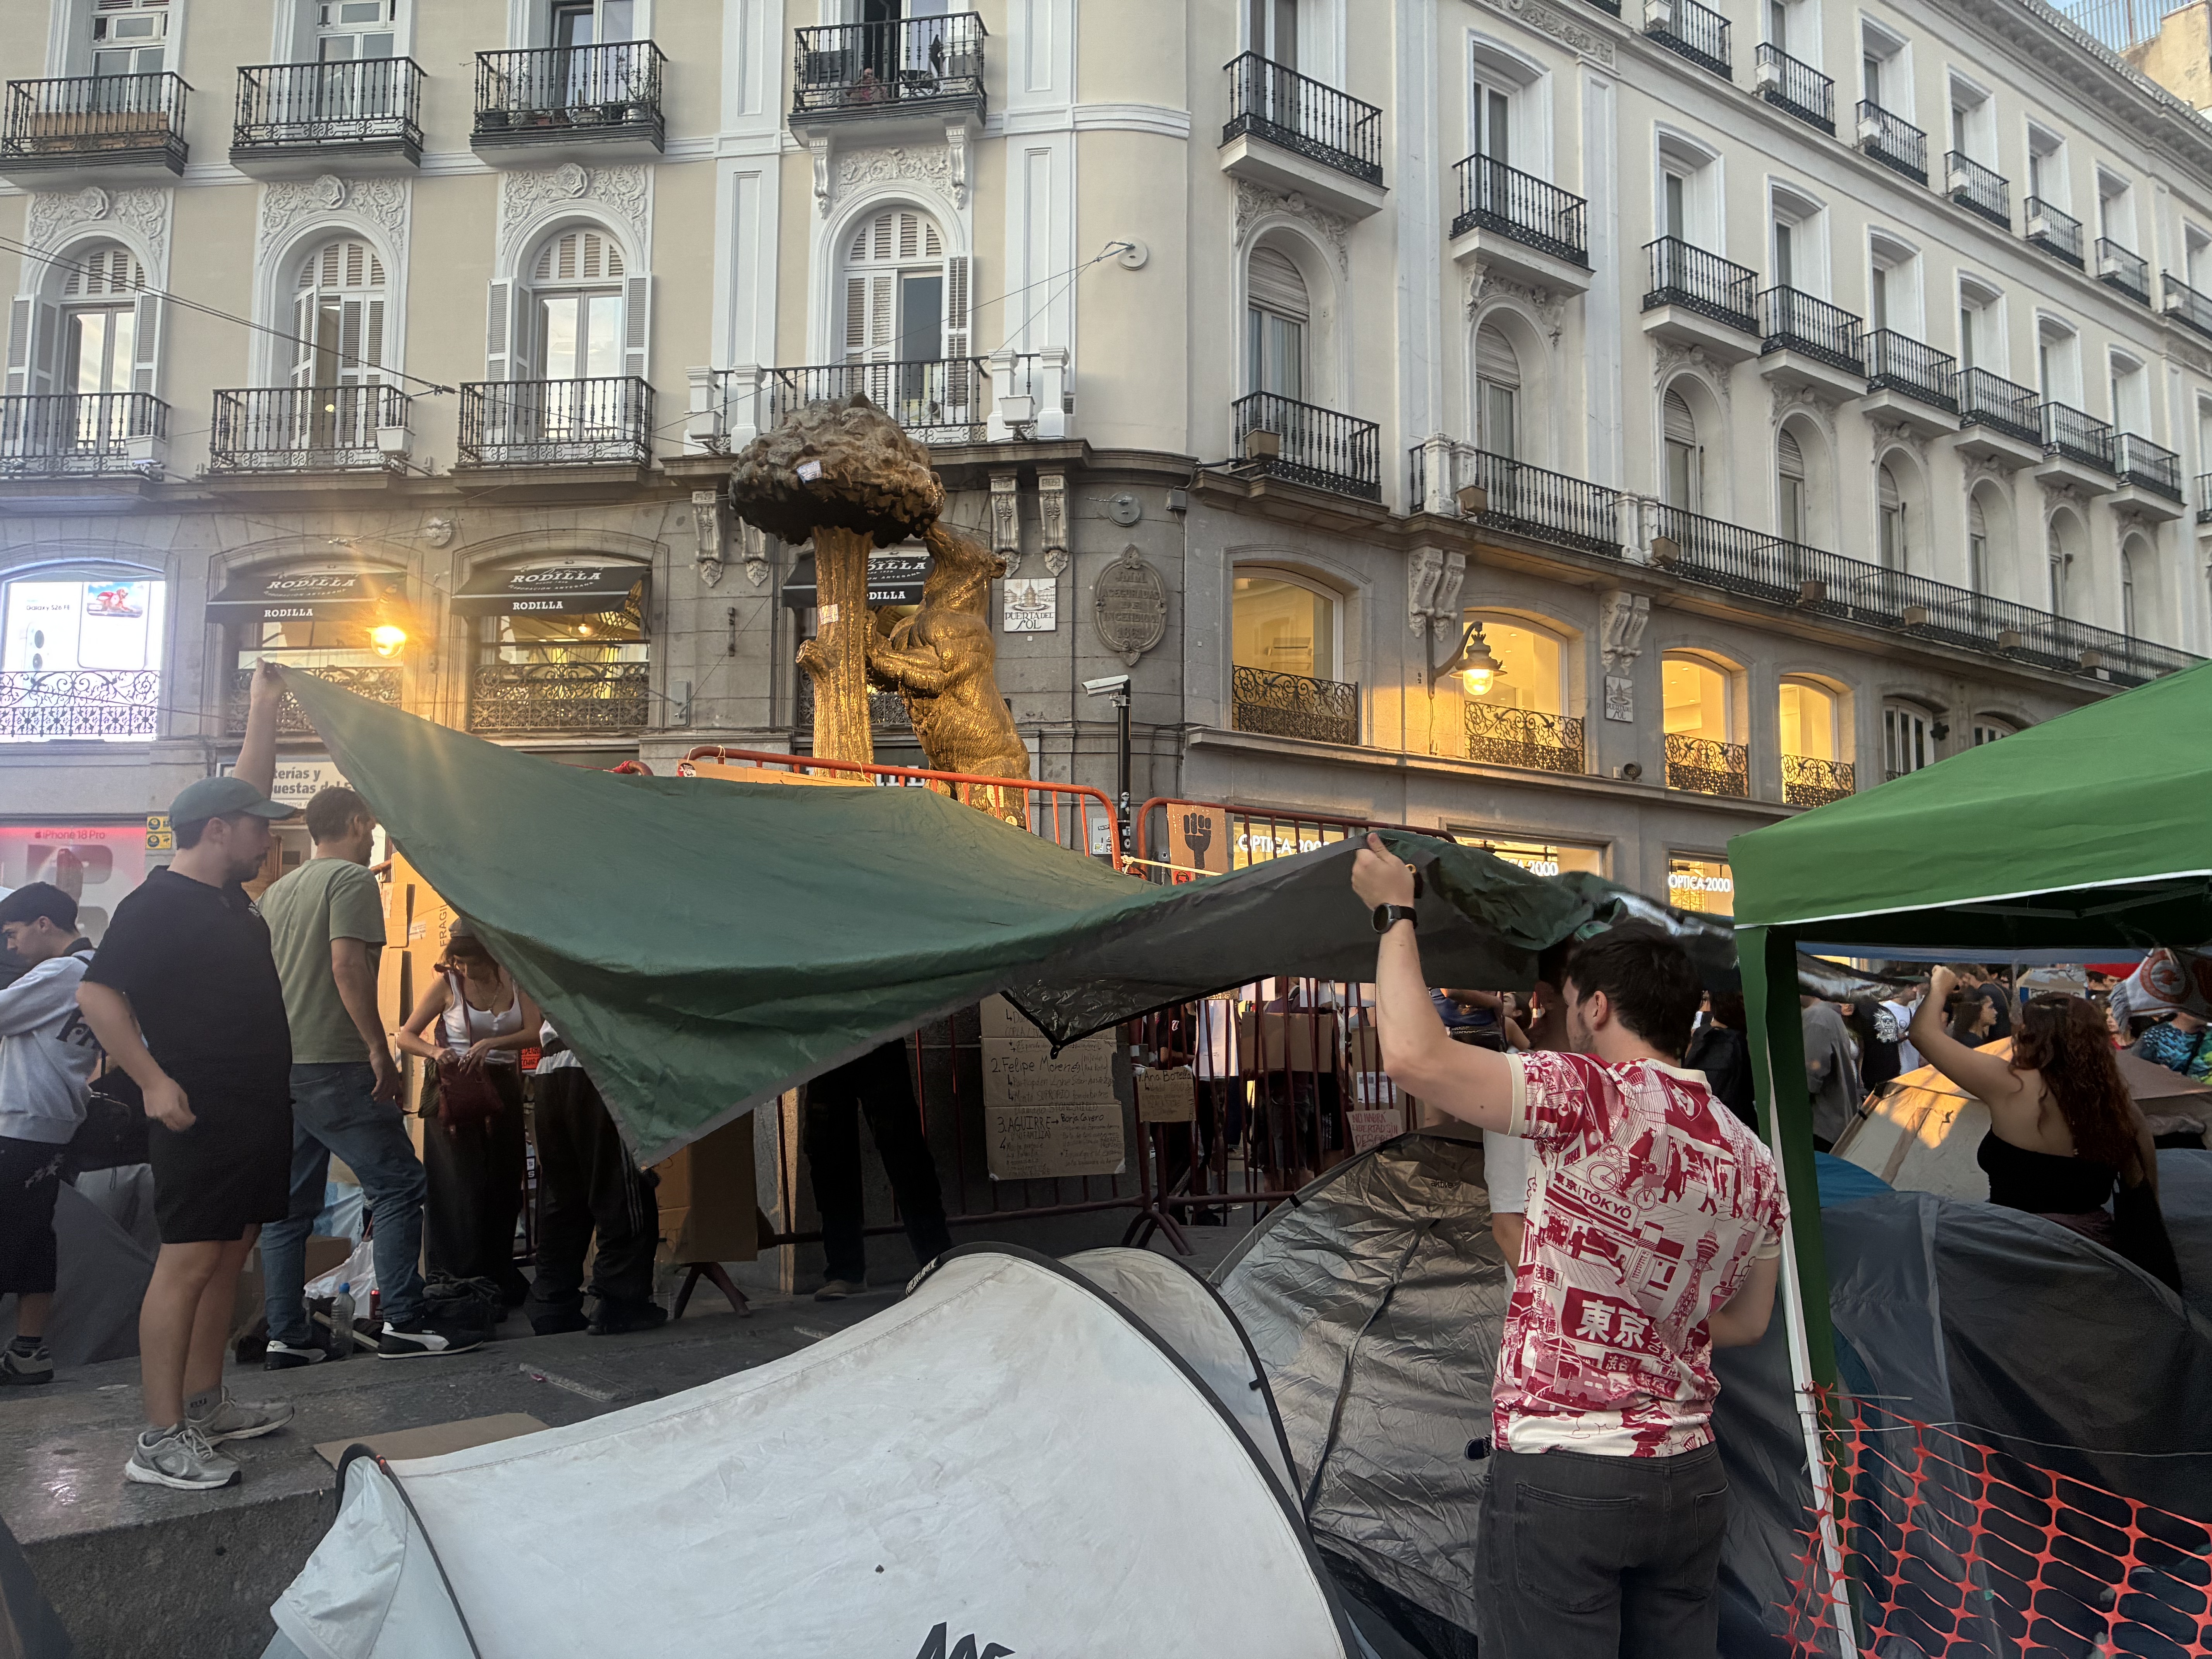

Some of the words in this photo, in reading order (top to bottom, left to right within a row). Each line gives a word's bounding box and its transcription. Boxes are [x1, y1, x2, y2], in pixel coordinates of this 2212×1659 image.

[867, 562, 926, 571] DILLA
[510, 573, 601, 583] RODILLA
[266, 579, 356, 589] RODILLA
[867, 591, 906, 600] DILLA
[512, 601, 563, 610] RODILLA
[264, 608, 313, 617] RODILLA
[1015, 620, 1042, 630] SOL
[1607, 703, 1626, 712] PUERTA
[1613, 711, 1626, 720] SOL
[274, 767, 309, 779] terías
[313, 769, 321, 781] y
[272, 782, 316, 794] uestas
[43, 830, 75, 840] iPhone
[77, 831, 88, 840] 18
[89, 831, 105, 839] Pro
[1528, 860, 1559, 876] 2000
[1668, 874, 1705, 891] OPTICA
[1705, 876, 1731, 892] 2000
[991, 1058, 1001, 1073] 2.
[1001, 1057, 1035, 1076] Felipe
[1144, 1069, 1161, 1082] Ana
[1060, 1113, 1079, 1124] Borja
[1080, 1113, 1104, 1121] Cavero
[1008, 1116, 1051, 1133] AGUIRRE
[1575, 1299, 1650, 1348] 東京
[1606, 1355, 1630, 1371] 渋谷
